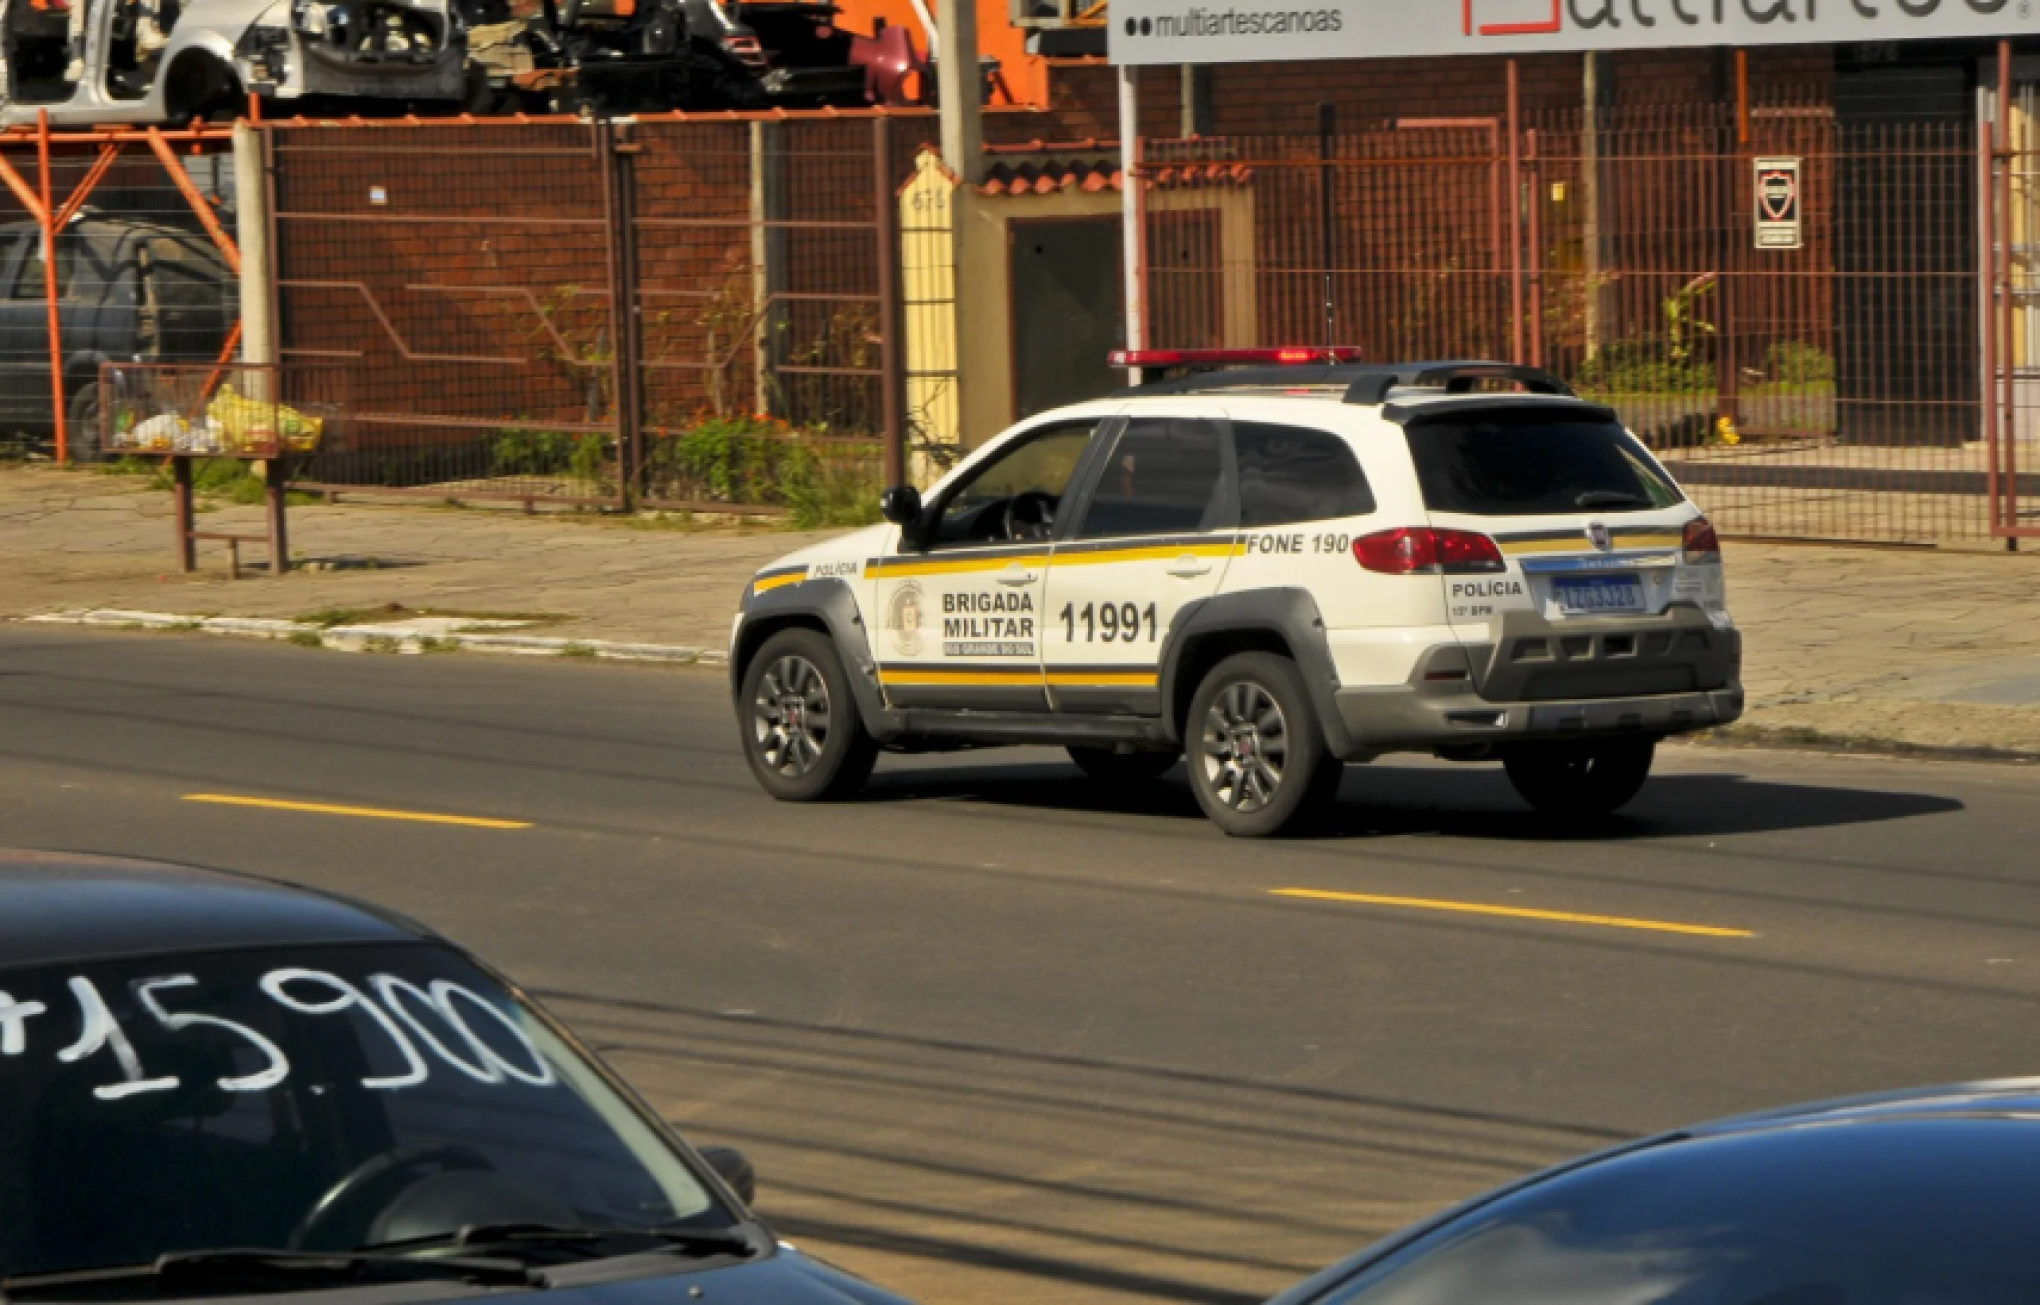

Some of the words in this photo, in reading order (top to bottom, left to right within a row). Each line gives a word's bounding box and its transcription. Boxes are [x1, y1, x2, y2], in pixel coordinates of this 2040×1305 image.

[1155, 7, 1342, 36] multiartescanoas
[1247, 533, 1304, 554] FONE
[1312, 533, 1349, 554] 190
[1452, 580, 1522, 598] POLÍCIA
[942, 592, 1033, 613] BRIGADA
[943, 617, 1033, 638] MILITAR
[1060, 601, 1157, 643] 11991
